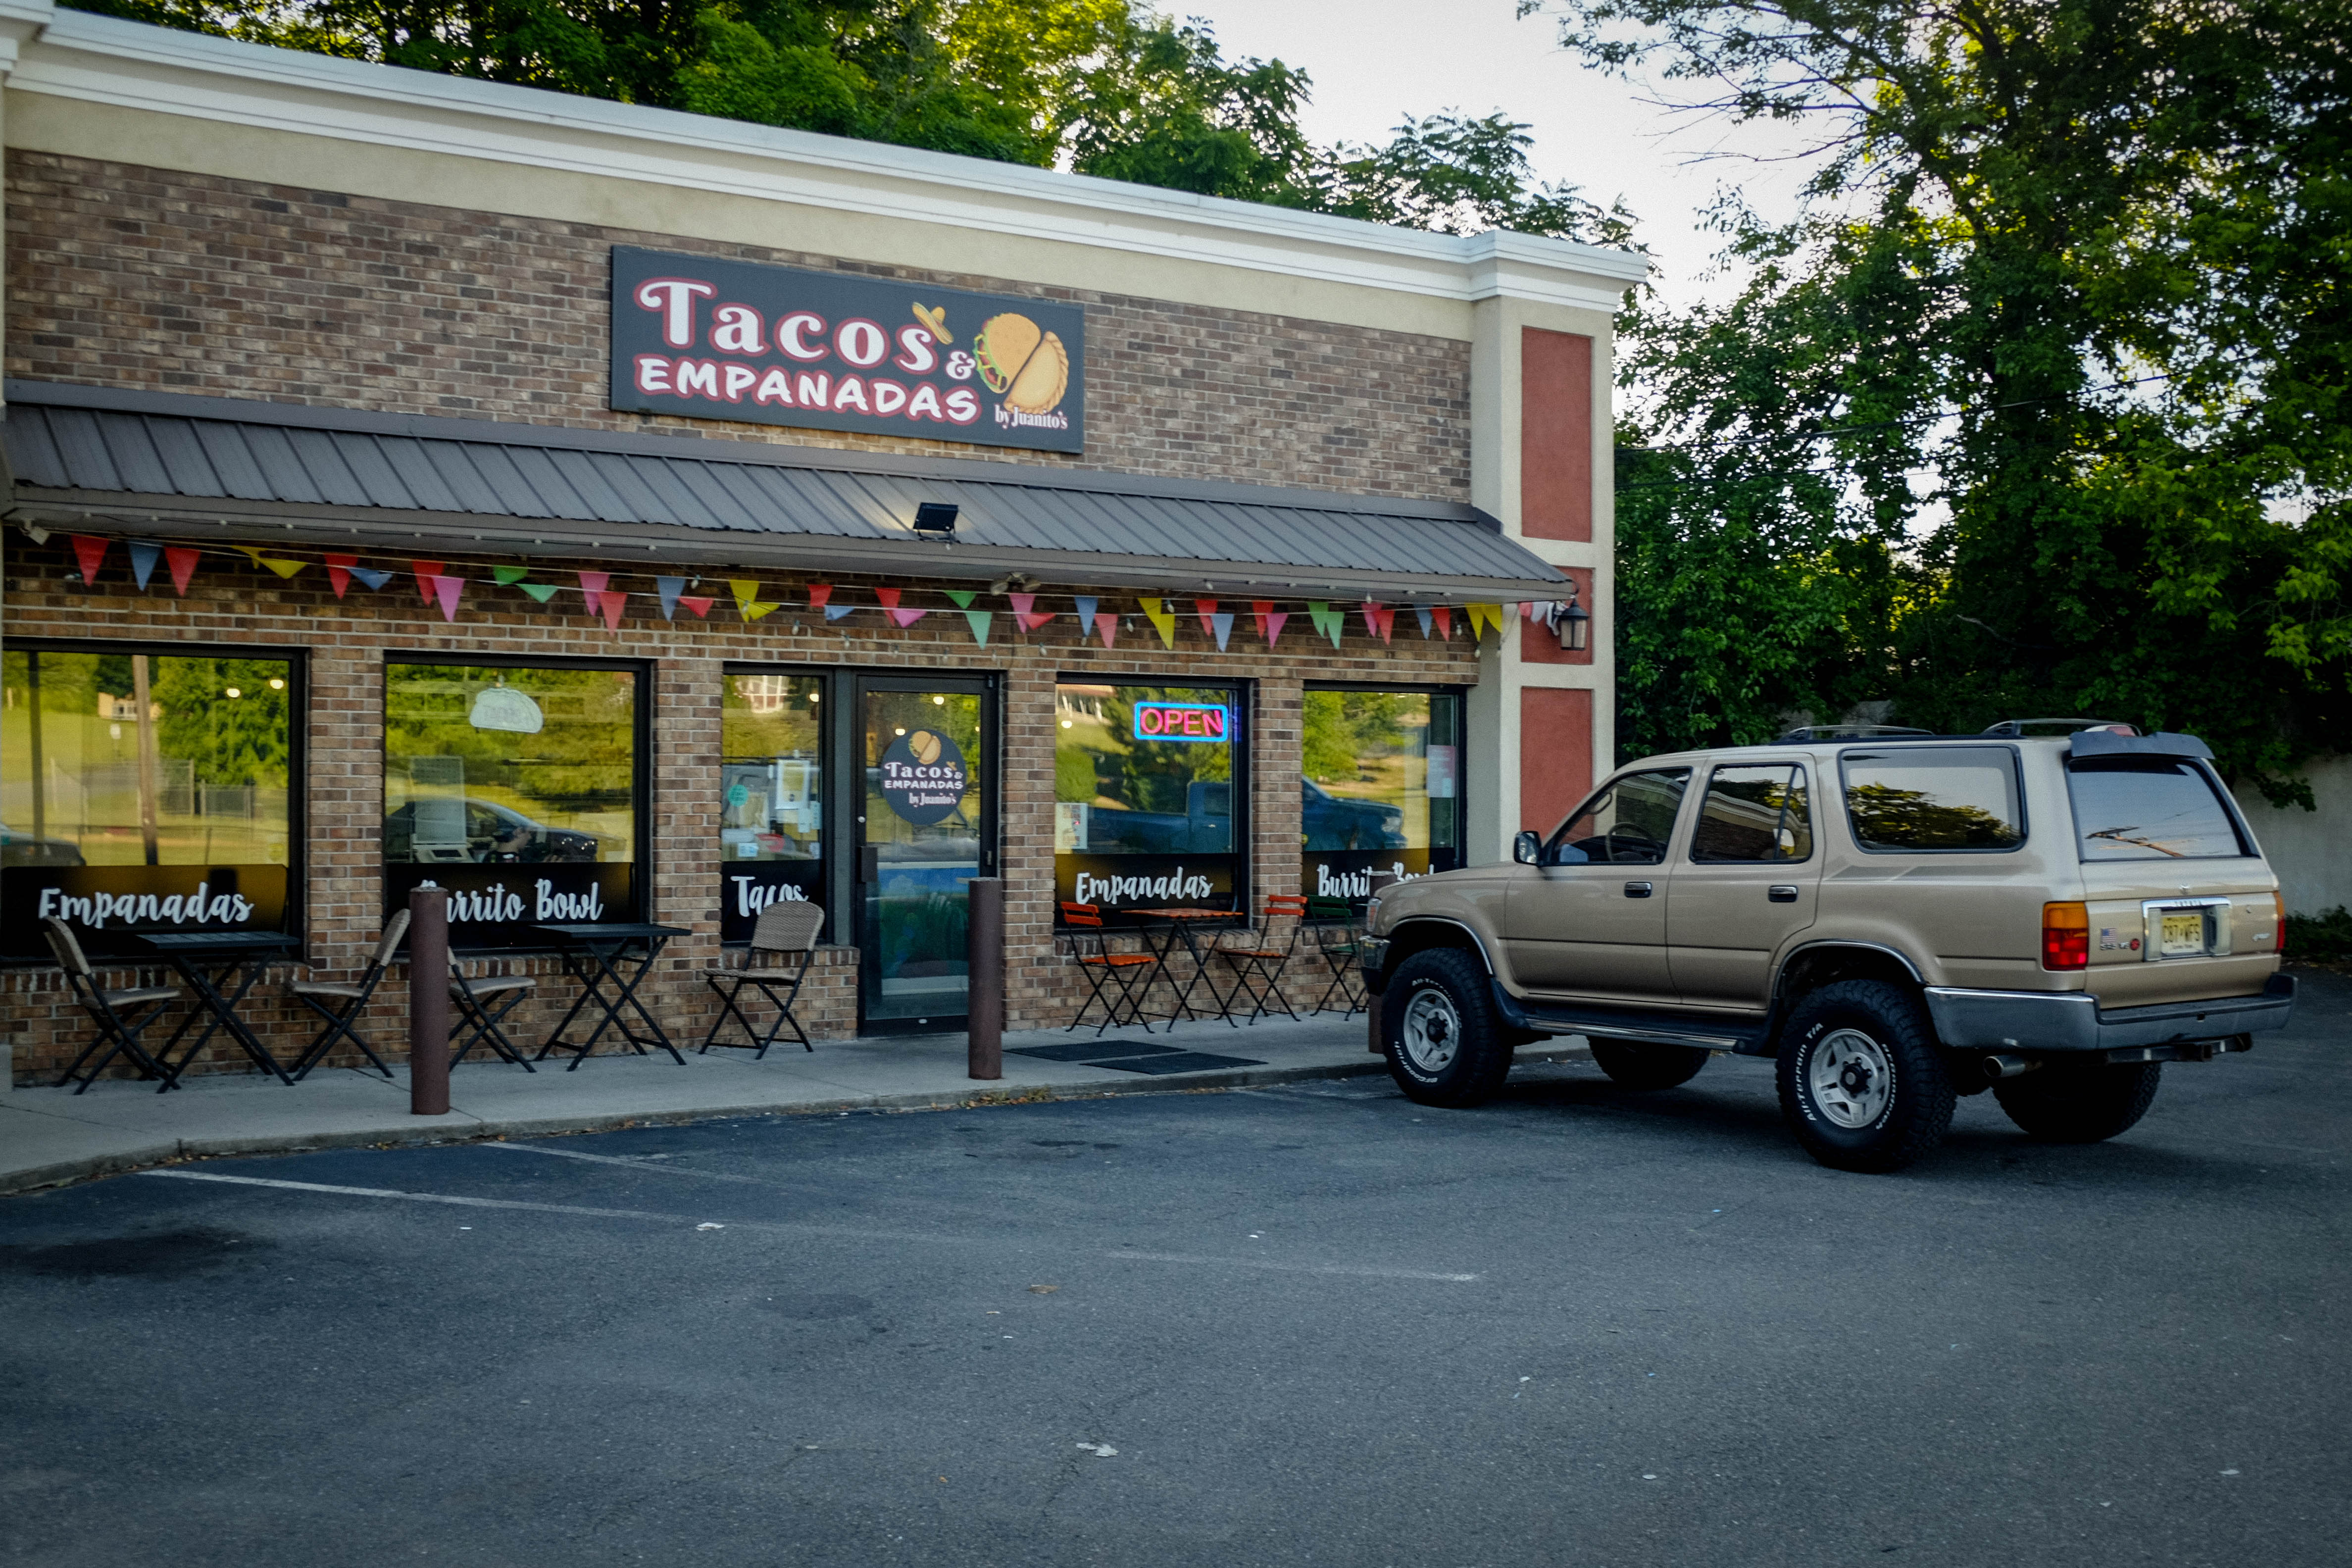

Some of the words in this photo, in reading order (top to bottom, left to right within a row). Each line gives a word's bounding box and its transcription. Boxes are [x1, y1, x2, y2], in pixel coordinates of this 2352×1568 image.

[637, 279, 939, 372] Tacos
[945, 350, 977, 380] &
[638, 357, 978, 421] EMPANADAS
[995, 404, 1009, 429] by
[1011, 406, 1068, 429] Juanito's
[1140, 708, 1223, 736] OPEN
[884, 762, 953, 778] Tacos
[884, 780, 964, 790] EMPANADAS
[1076, 866, 1213, 905] Empanadas
[1317, 864, 1373, 898] Burrit
[39, 882, 254, 929] Empanadas
[421, 879, 526, 922] rrito
[534, 878, 604, 920] Bowl
